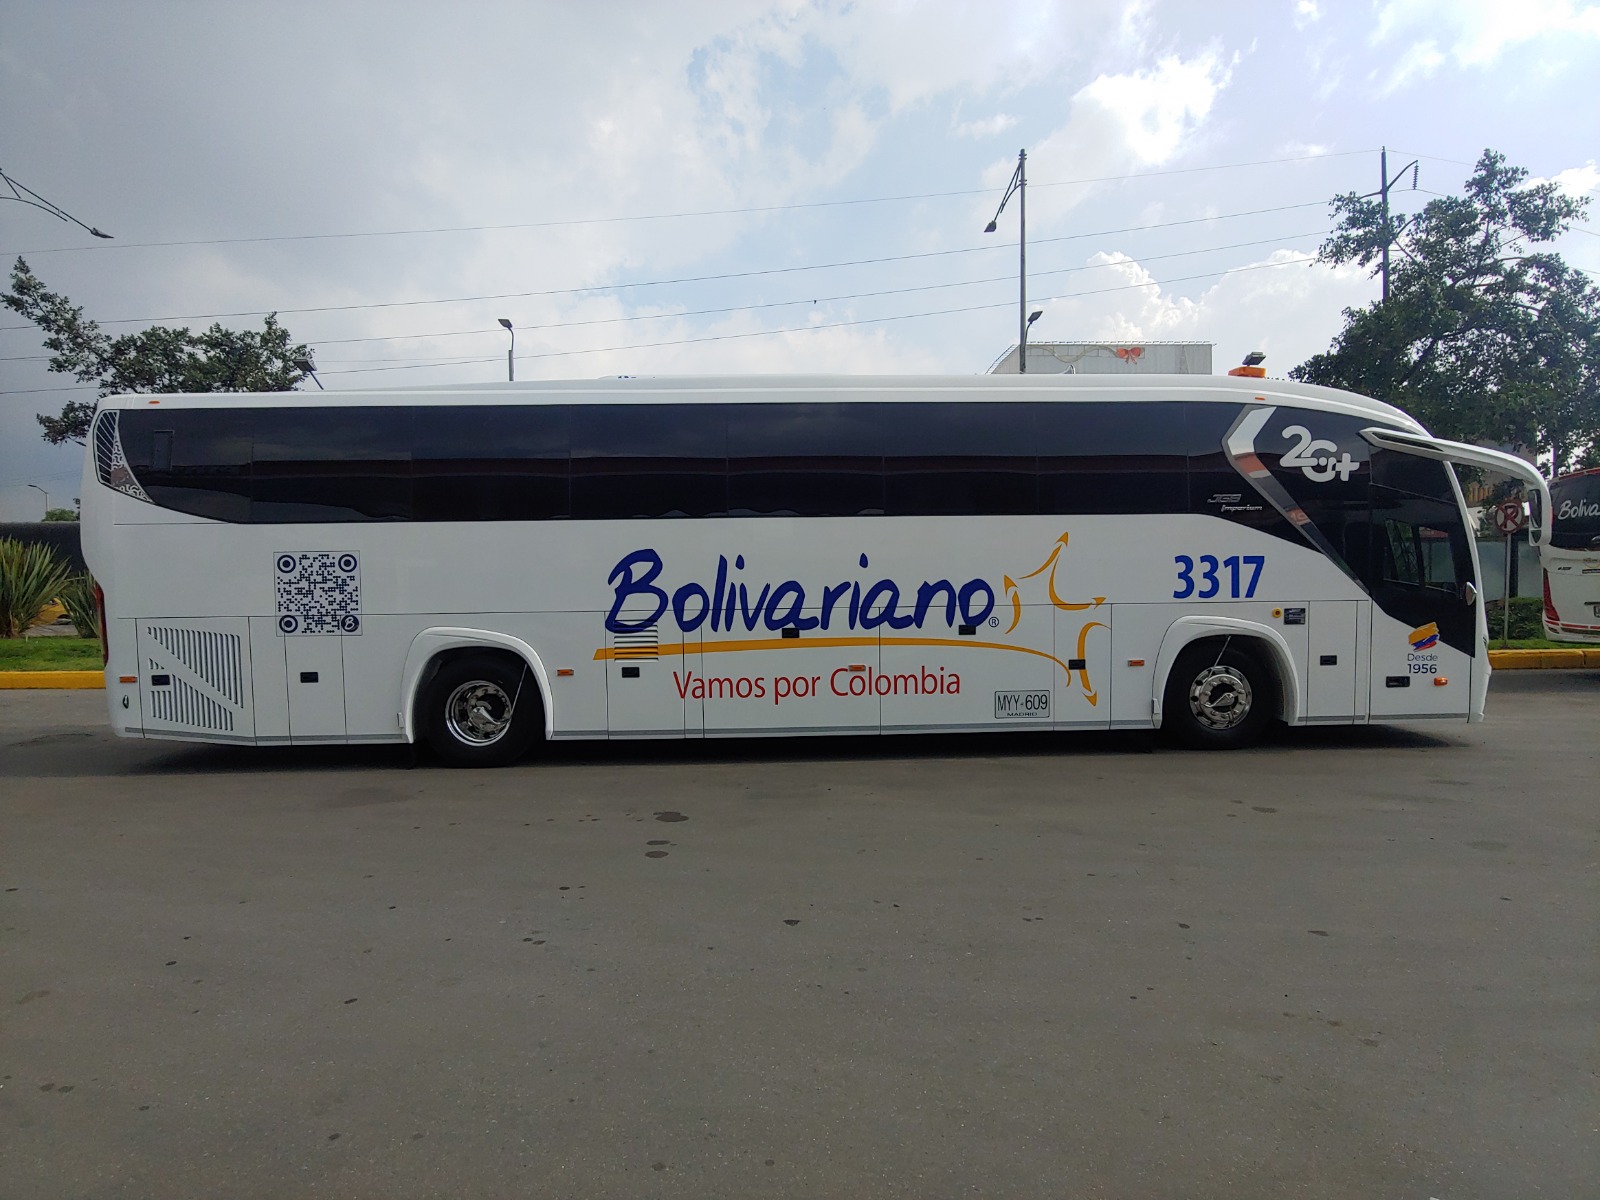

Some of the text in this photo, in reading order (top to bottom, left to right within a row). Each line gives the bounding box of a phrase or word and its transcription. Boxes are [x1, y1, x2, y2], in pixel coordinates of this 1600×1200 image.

[605, 549, 994, 632] Bolivariano
[1173, 554, 1265, 598] 3317
[1407, 653, 1438, 661] Desde
[1407, 663, 1437, 674] 1956
[673, 666, 961, 705] Vamos por Colombia
